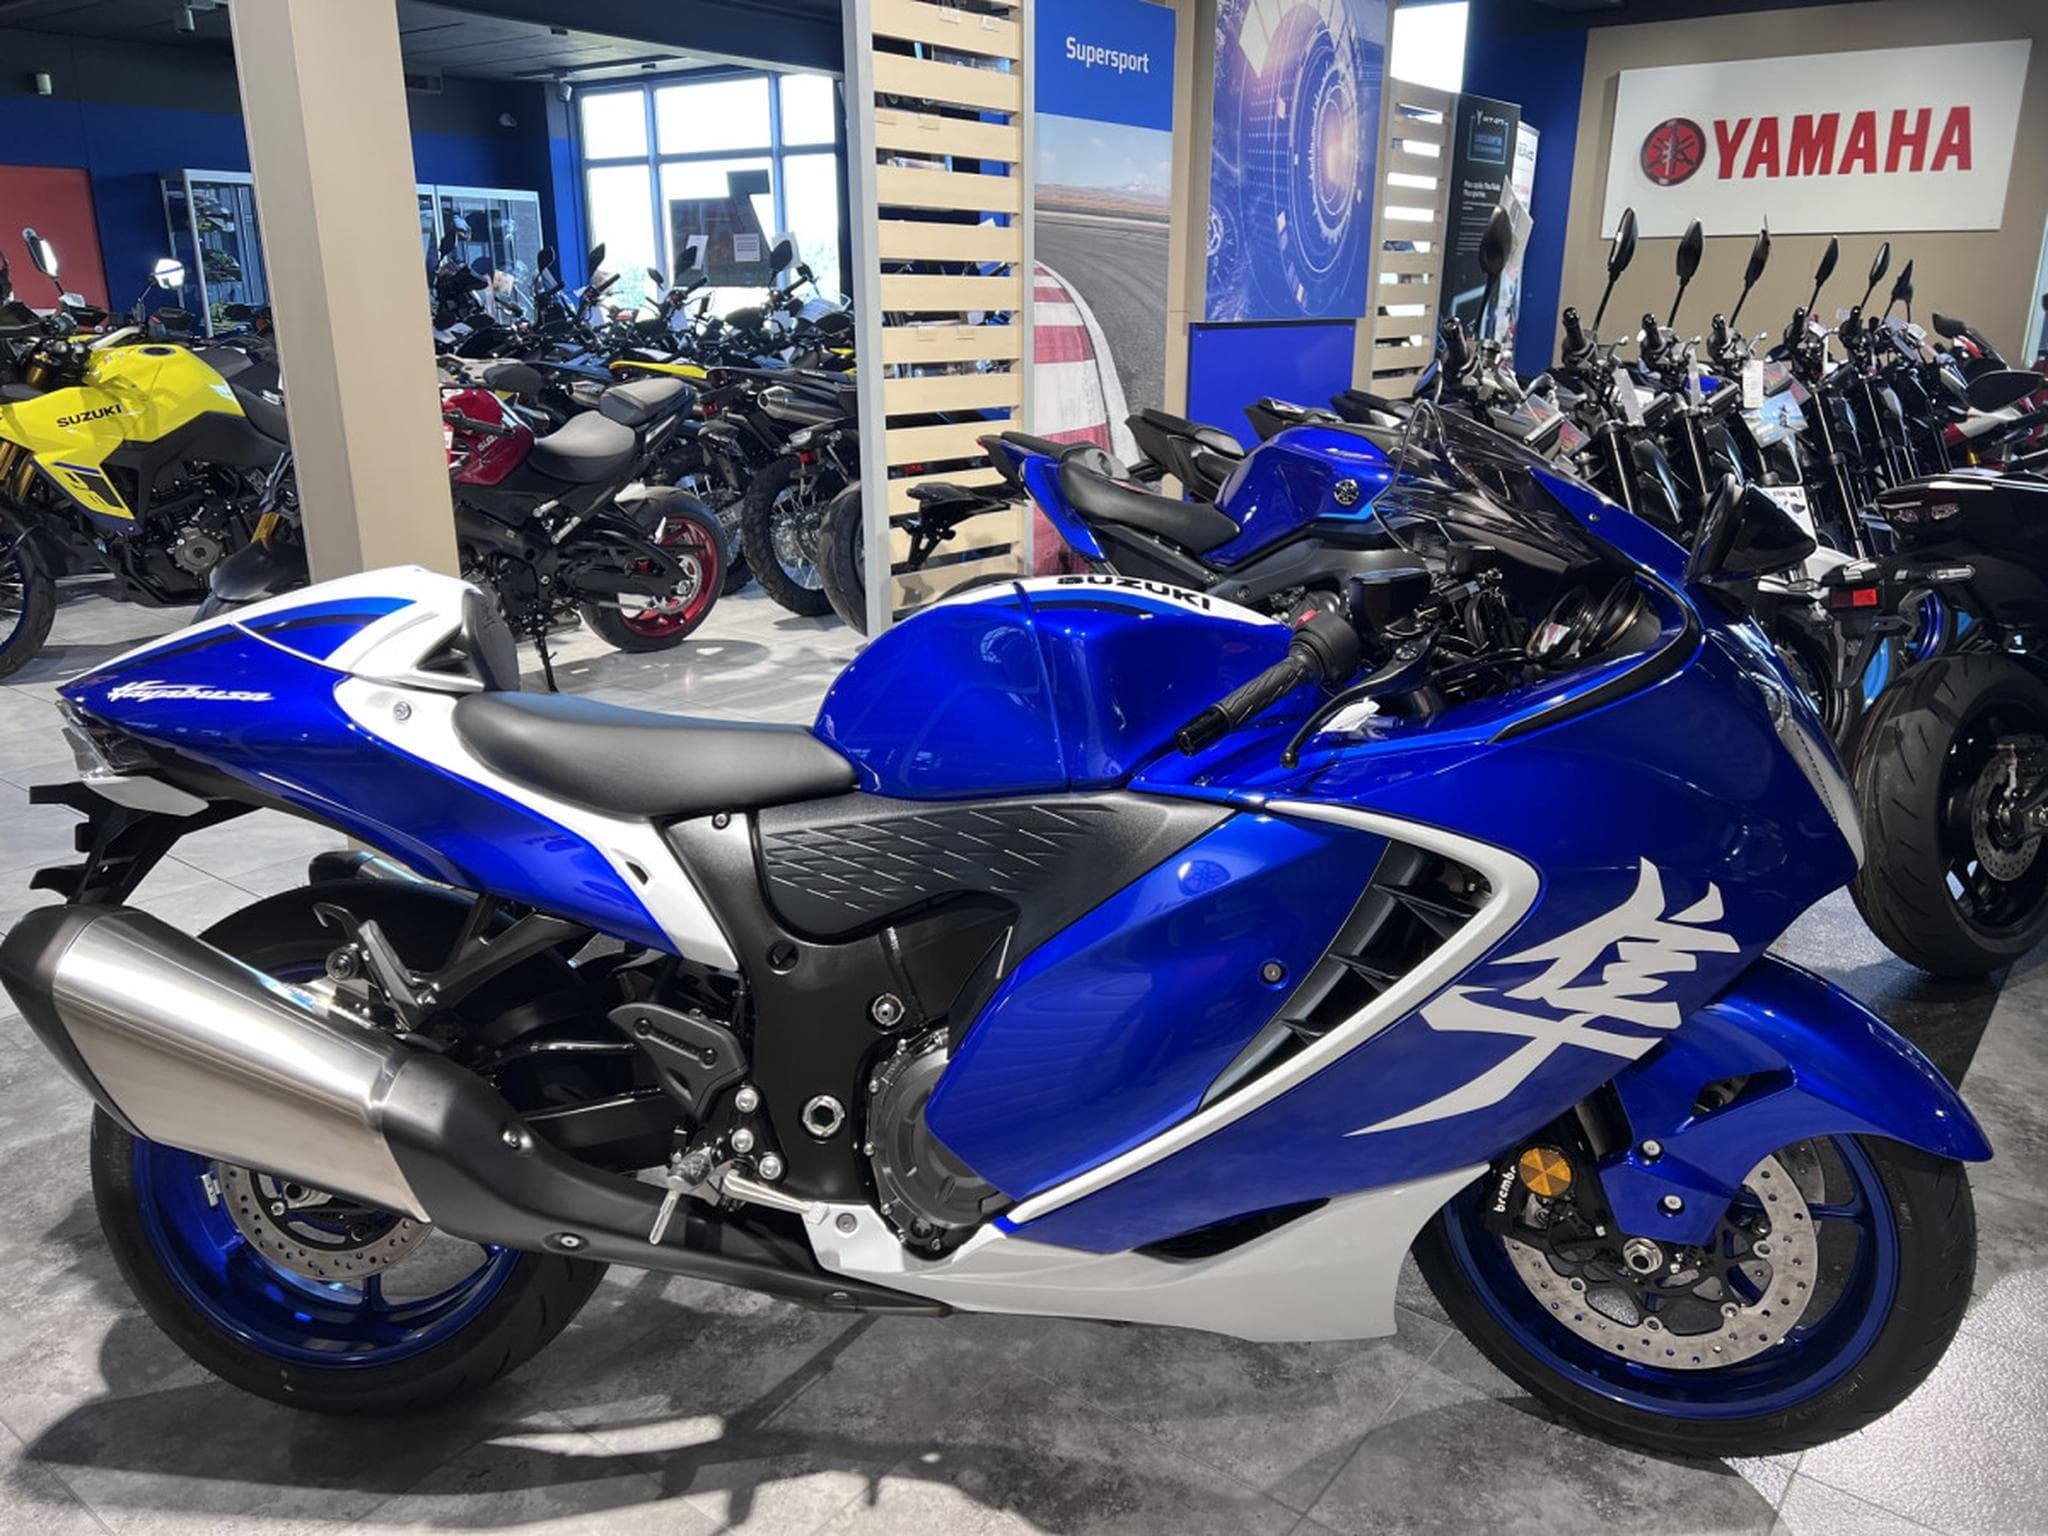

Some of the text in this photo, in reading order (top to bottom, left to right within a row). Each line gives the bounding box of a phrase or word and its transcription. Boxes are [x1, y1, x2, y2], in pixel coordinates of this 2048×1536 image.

[1066, 36, 1149, 74] Supersport
[1713, 106, 1972, 180] YAMAHA
[57, 404, 122, 428] SUZUKI
[1057, 576, 1211, 611] SUZUKI
[107, 680, 276, 702] Hayabusa
